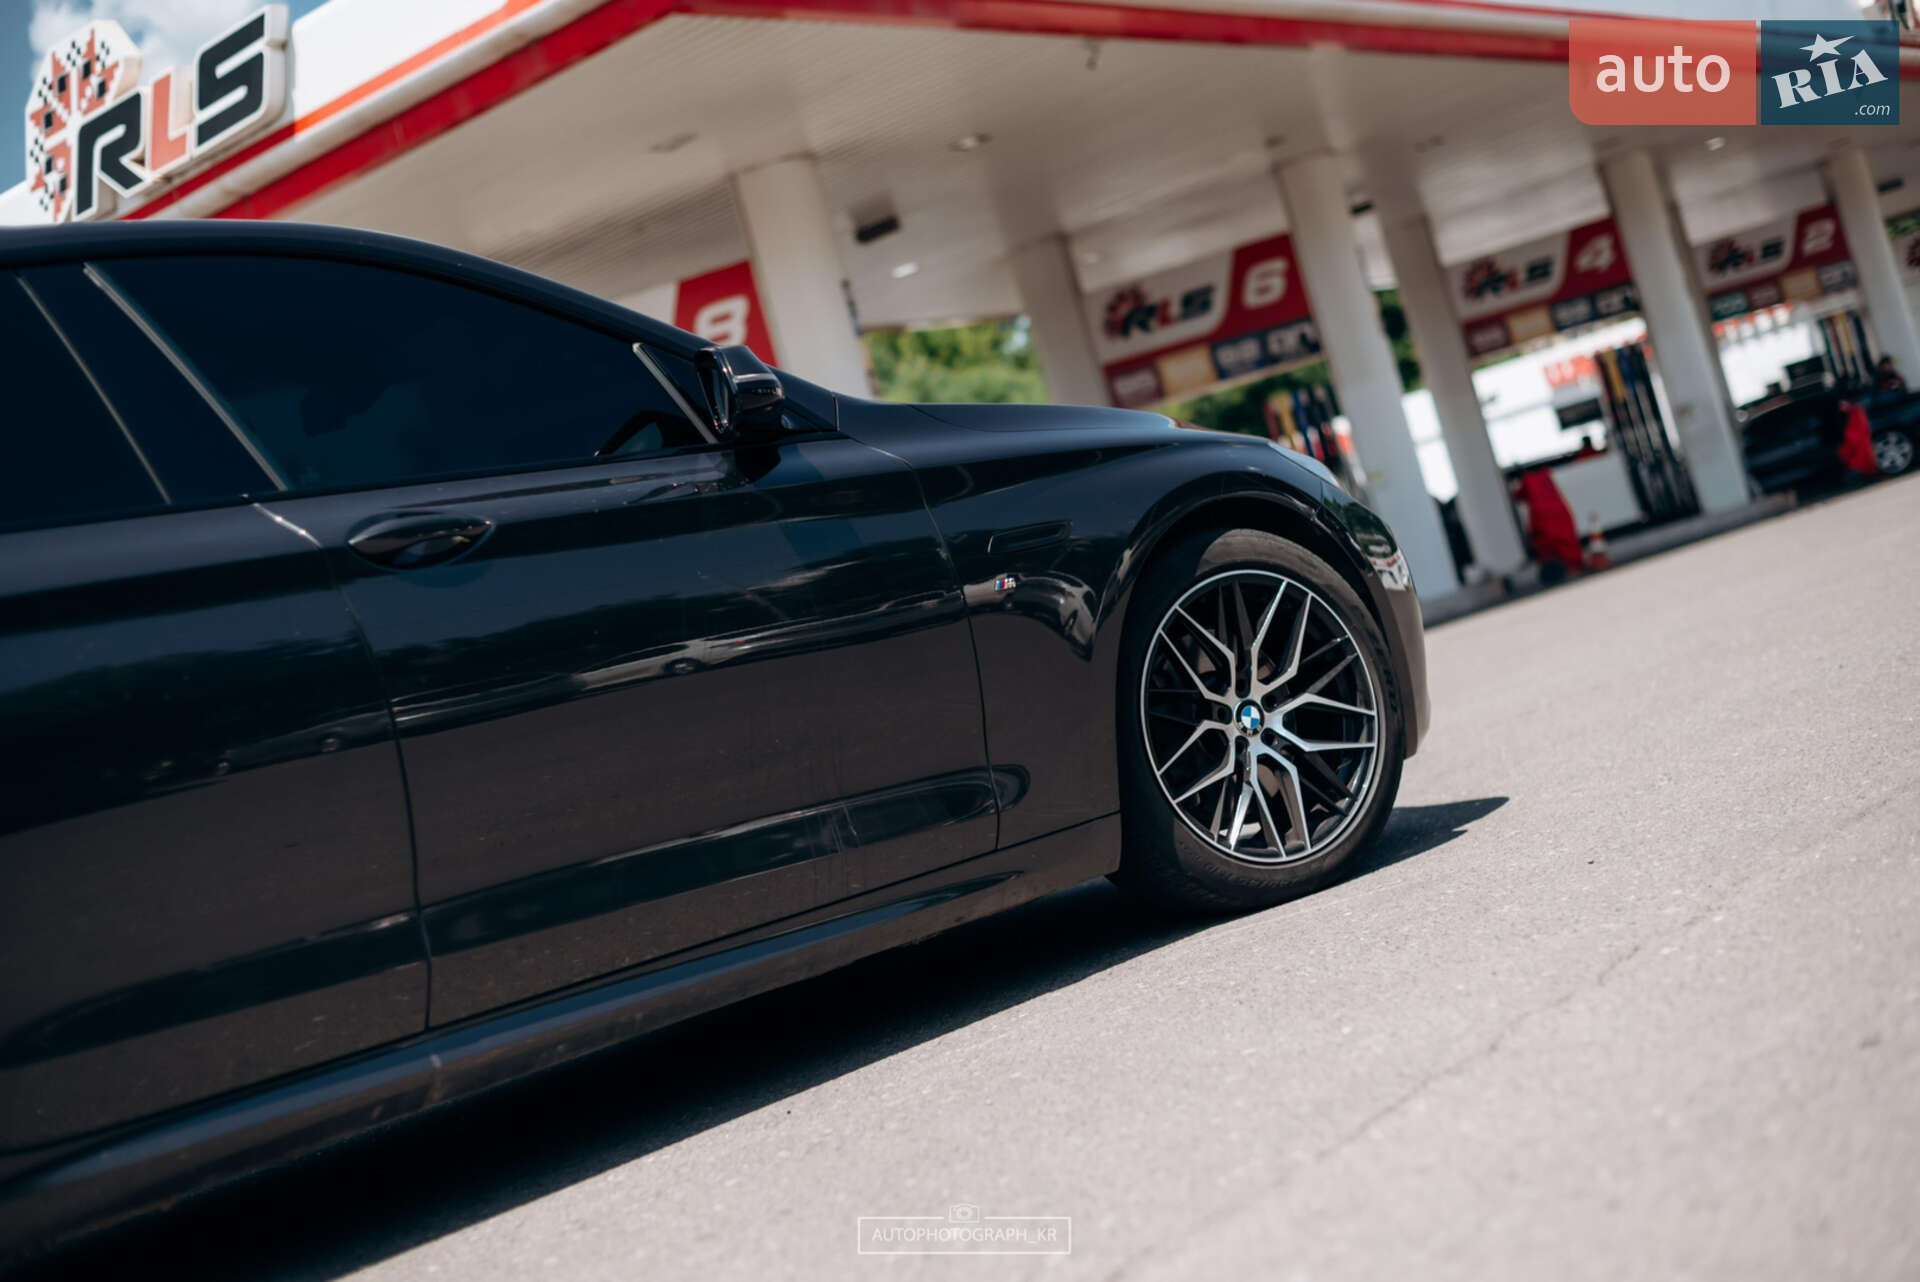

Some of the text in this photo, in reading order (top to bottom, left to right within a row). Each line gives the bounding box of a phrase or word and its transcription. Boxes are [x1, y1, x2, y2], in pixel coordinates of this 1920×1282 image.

[75, 12, 266, 216] RLS
[1574, 234, 1616, 273] 4
[1241, 256, 1290, 310] 6
[694, 293, 750, 348] 8
